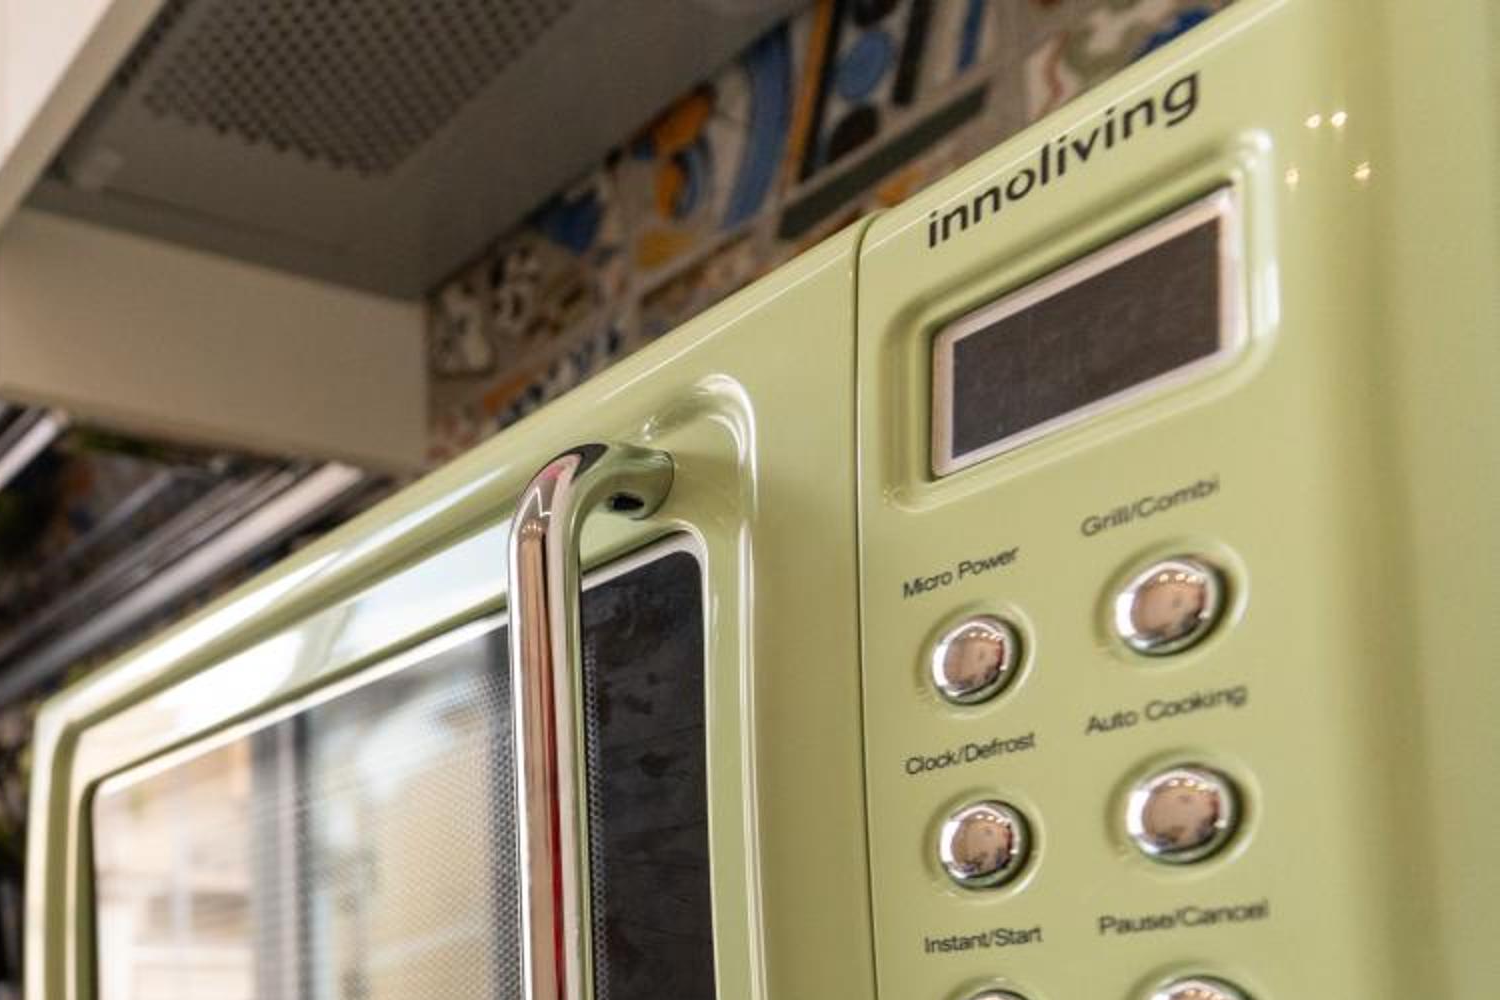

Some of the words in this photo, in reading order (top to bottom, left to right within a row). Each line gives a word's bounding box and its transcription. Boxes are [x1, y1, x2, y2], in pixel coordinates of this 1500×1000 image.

[928, 71, 1199, 249] innoliving
[1080, 474, 1220, 538] Grill/Combi
[903, 571, 953, 600] Micro
[958, 546, 1020, 580] Power
[1084, 710, 1139, 736] Auto
[1145, 685, 1248, 721] Cooking
[905, 732, 1035, 775] Clock/Defrost
[924, 925, 1043, 954] Instant/Start
[1098, 897, 1269, 935] Pause/Cancel
